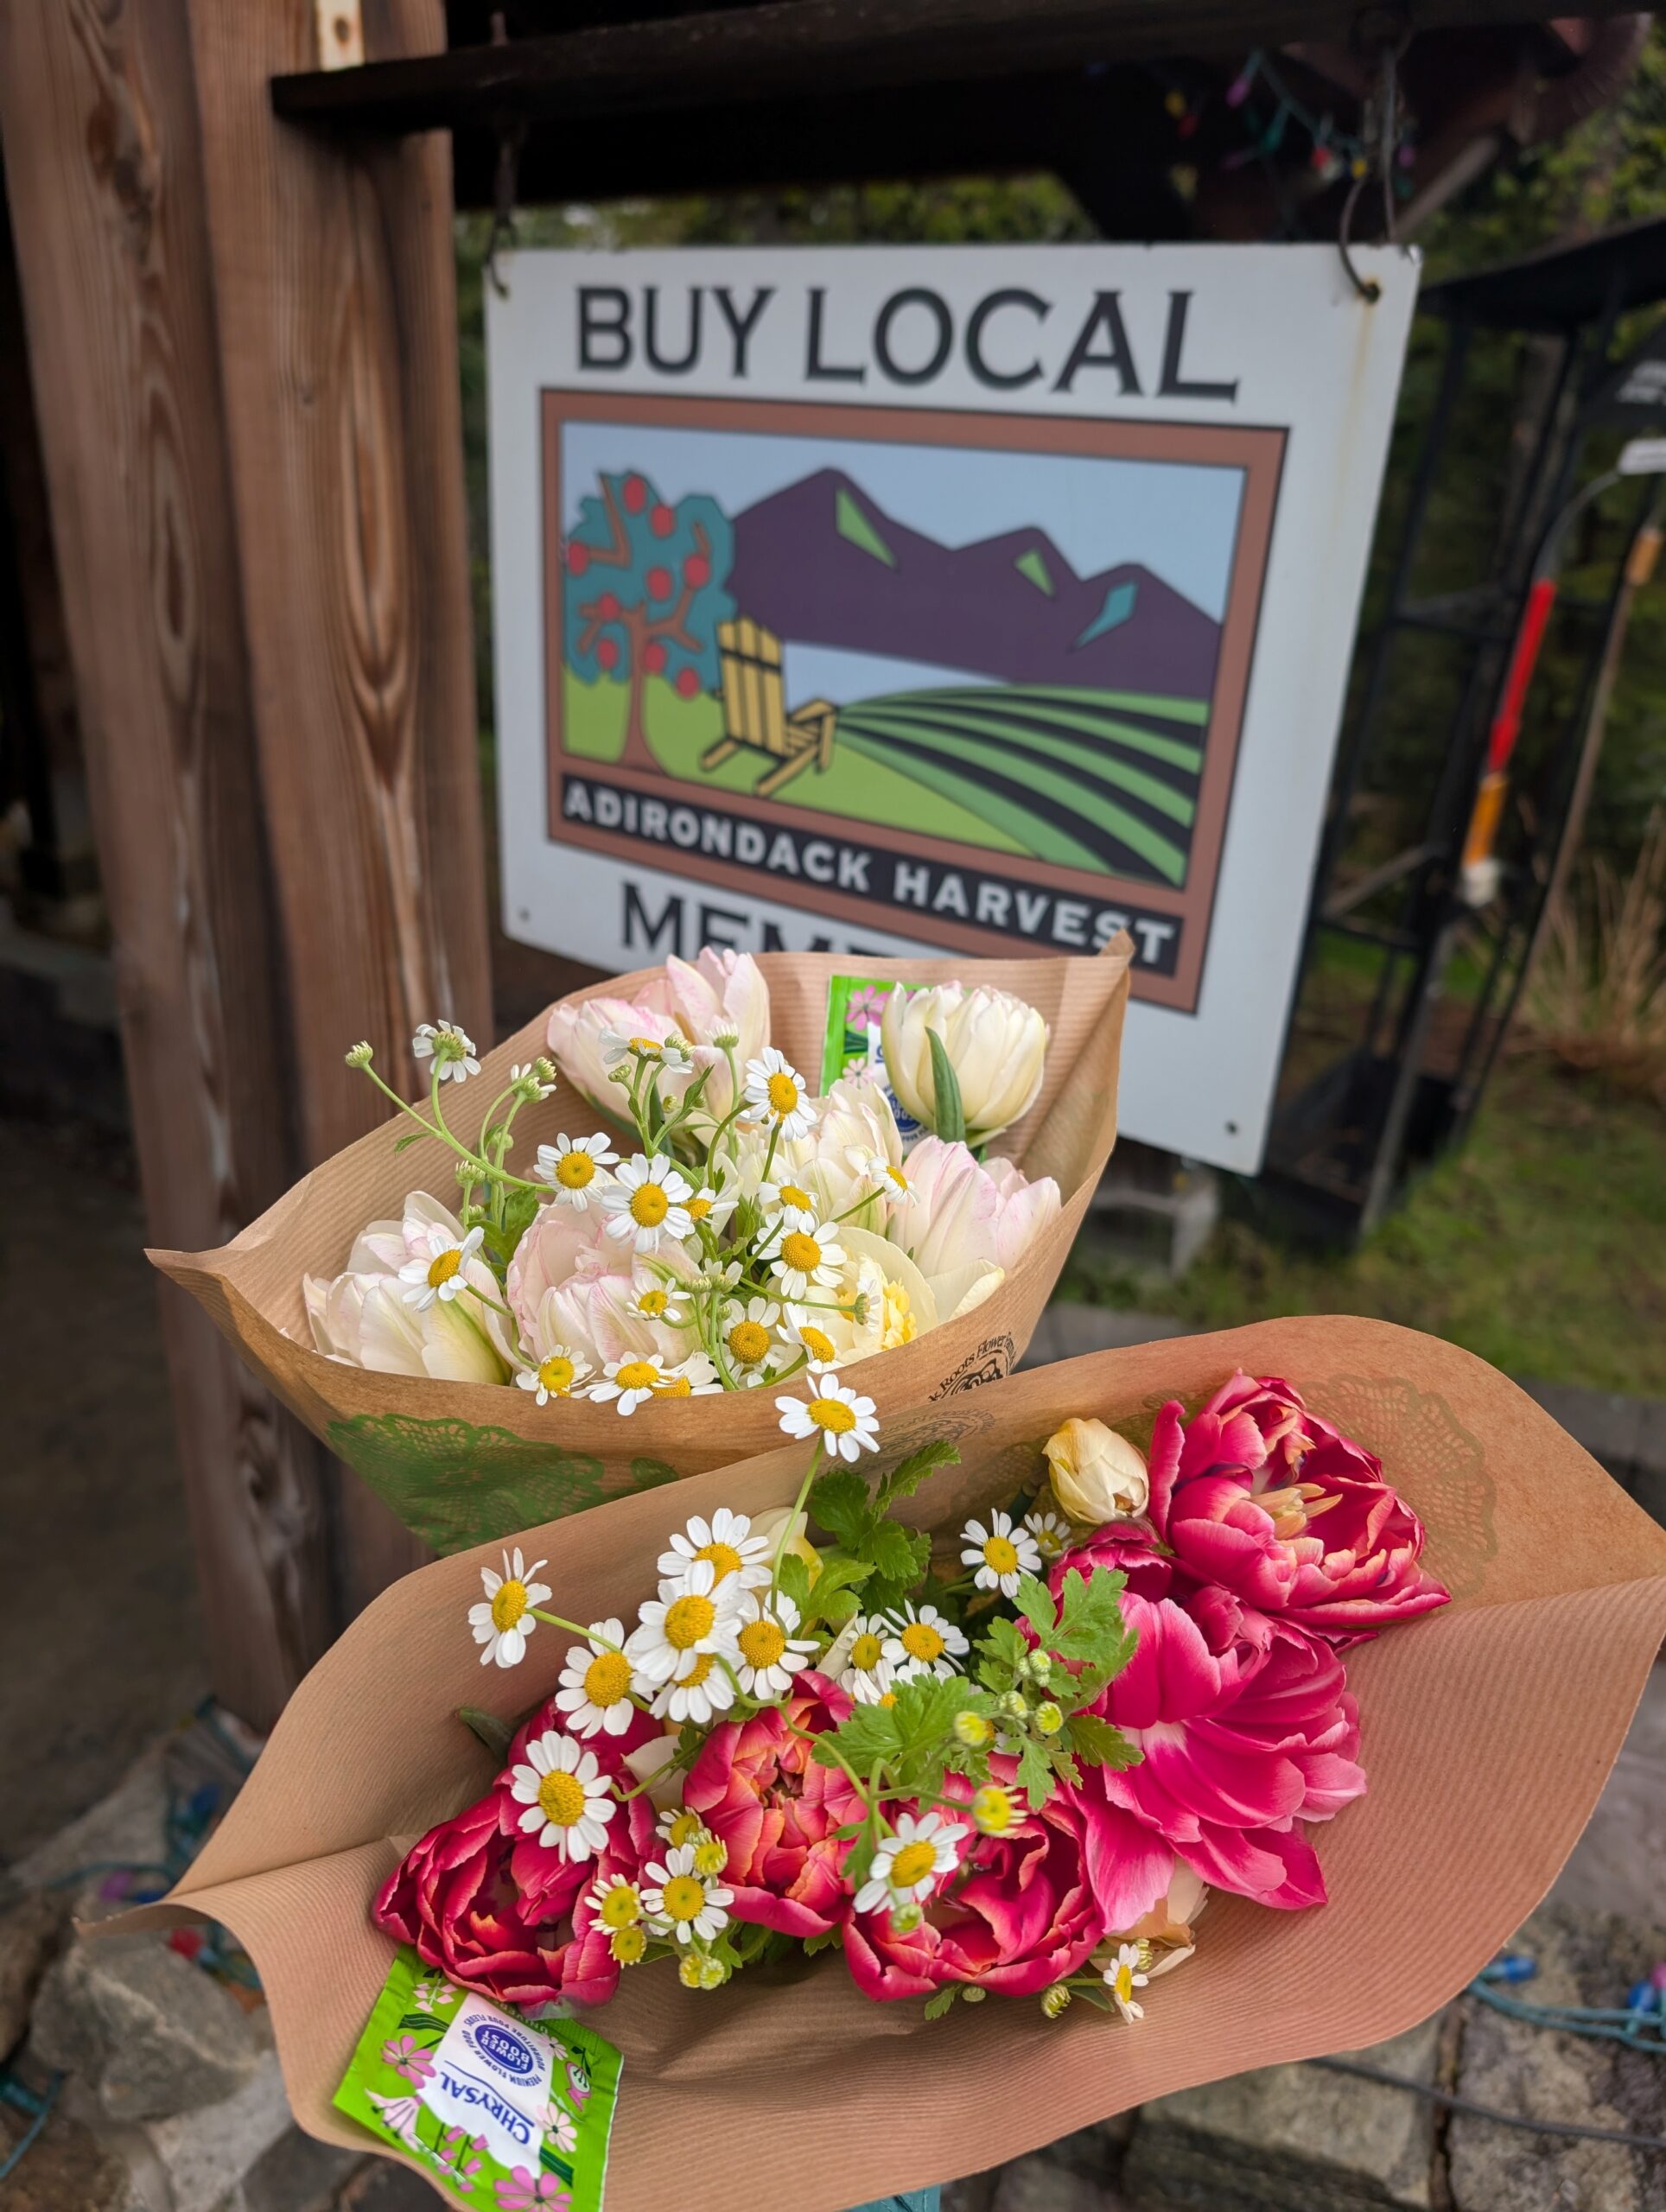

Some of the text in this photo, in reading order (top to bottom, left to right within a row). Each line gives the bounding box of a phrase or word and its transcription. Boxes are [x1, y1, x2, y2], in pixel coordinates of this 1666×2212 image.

[577, 286, 1239, 403] BUY LOCAL
[564, 782, 1173, 963] ADIRONDACK HARVEST
[939, 1352, 975, 1391] Roots
[474, 2050, 507, 2078] FLOWER
[480, 2037, 528, 2070] FLOWER
[482, 2031, 530, 2063] BOOST
[509, 2074, 542, 2087] PREMIUM
[440, 2071, 530, 2145] CHRYSAL
